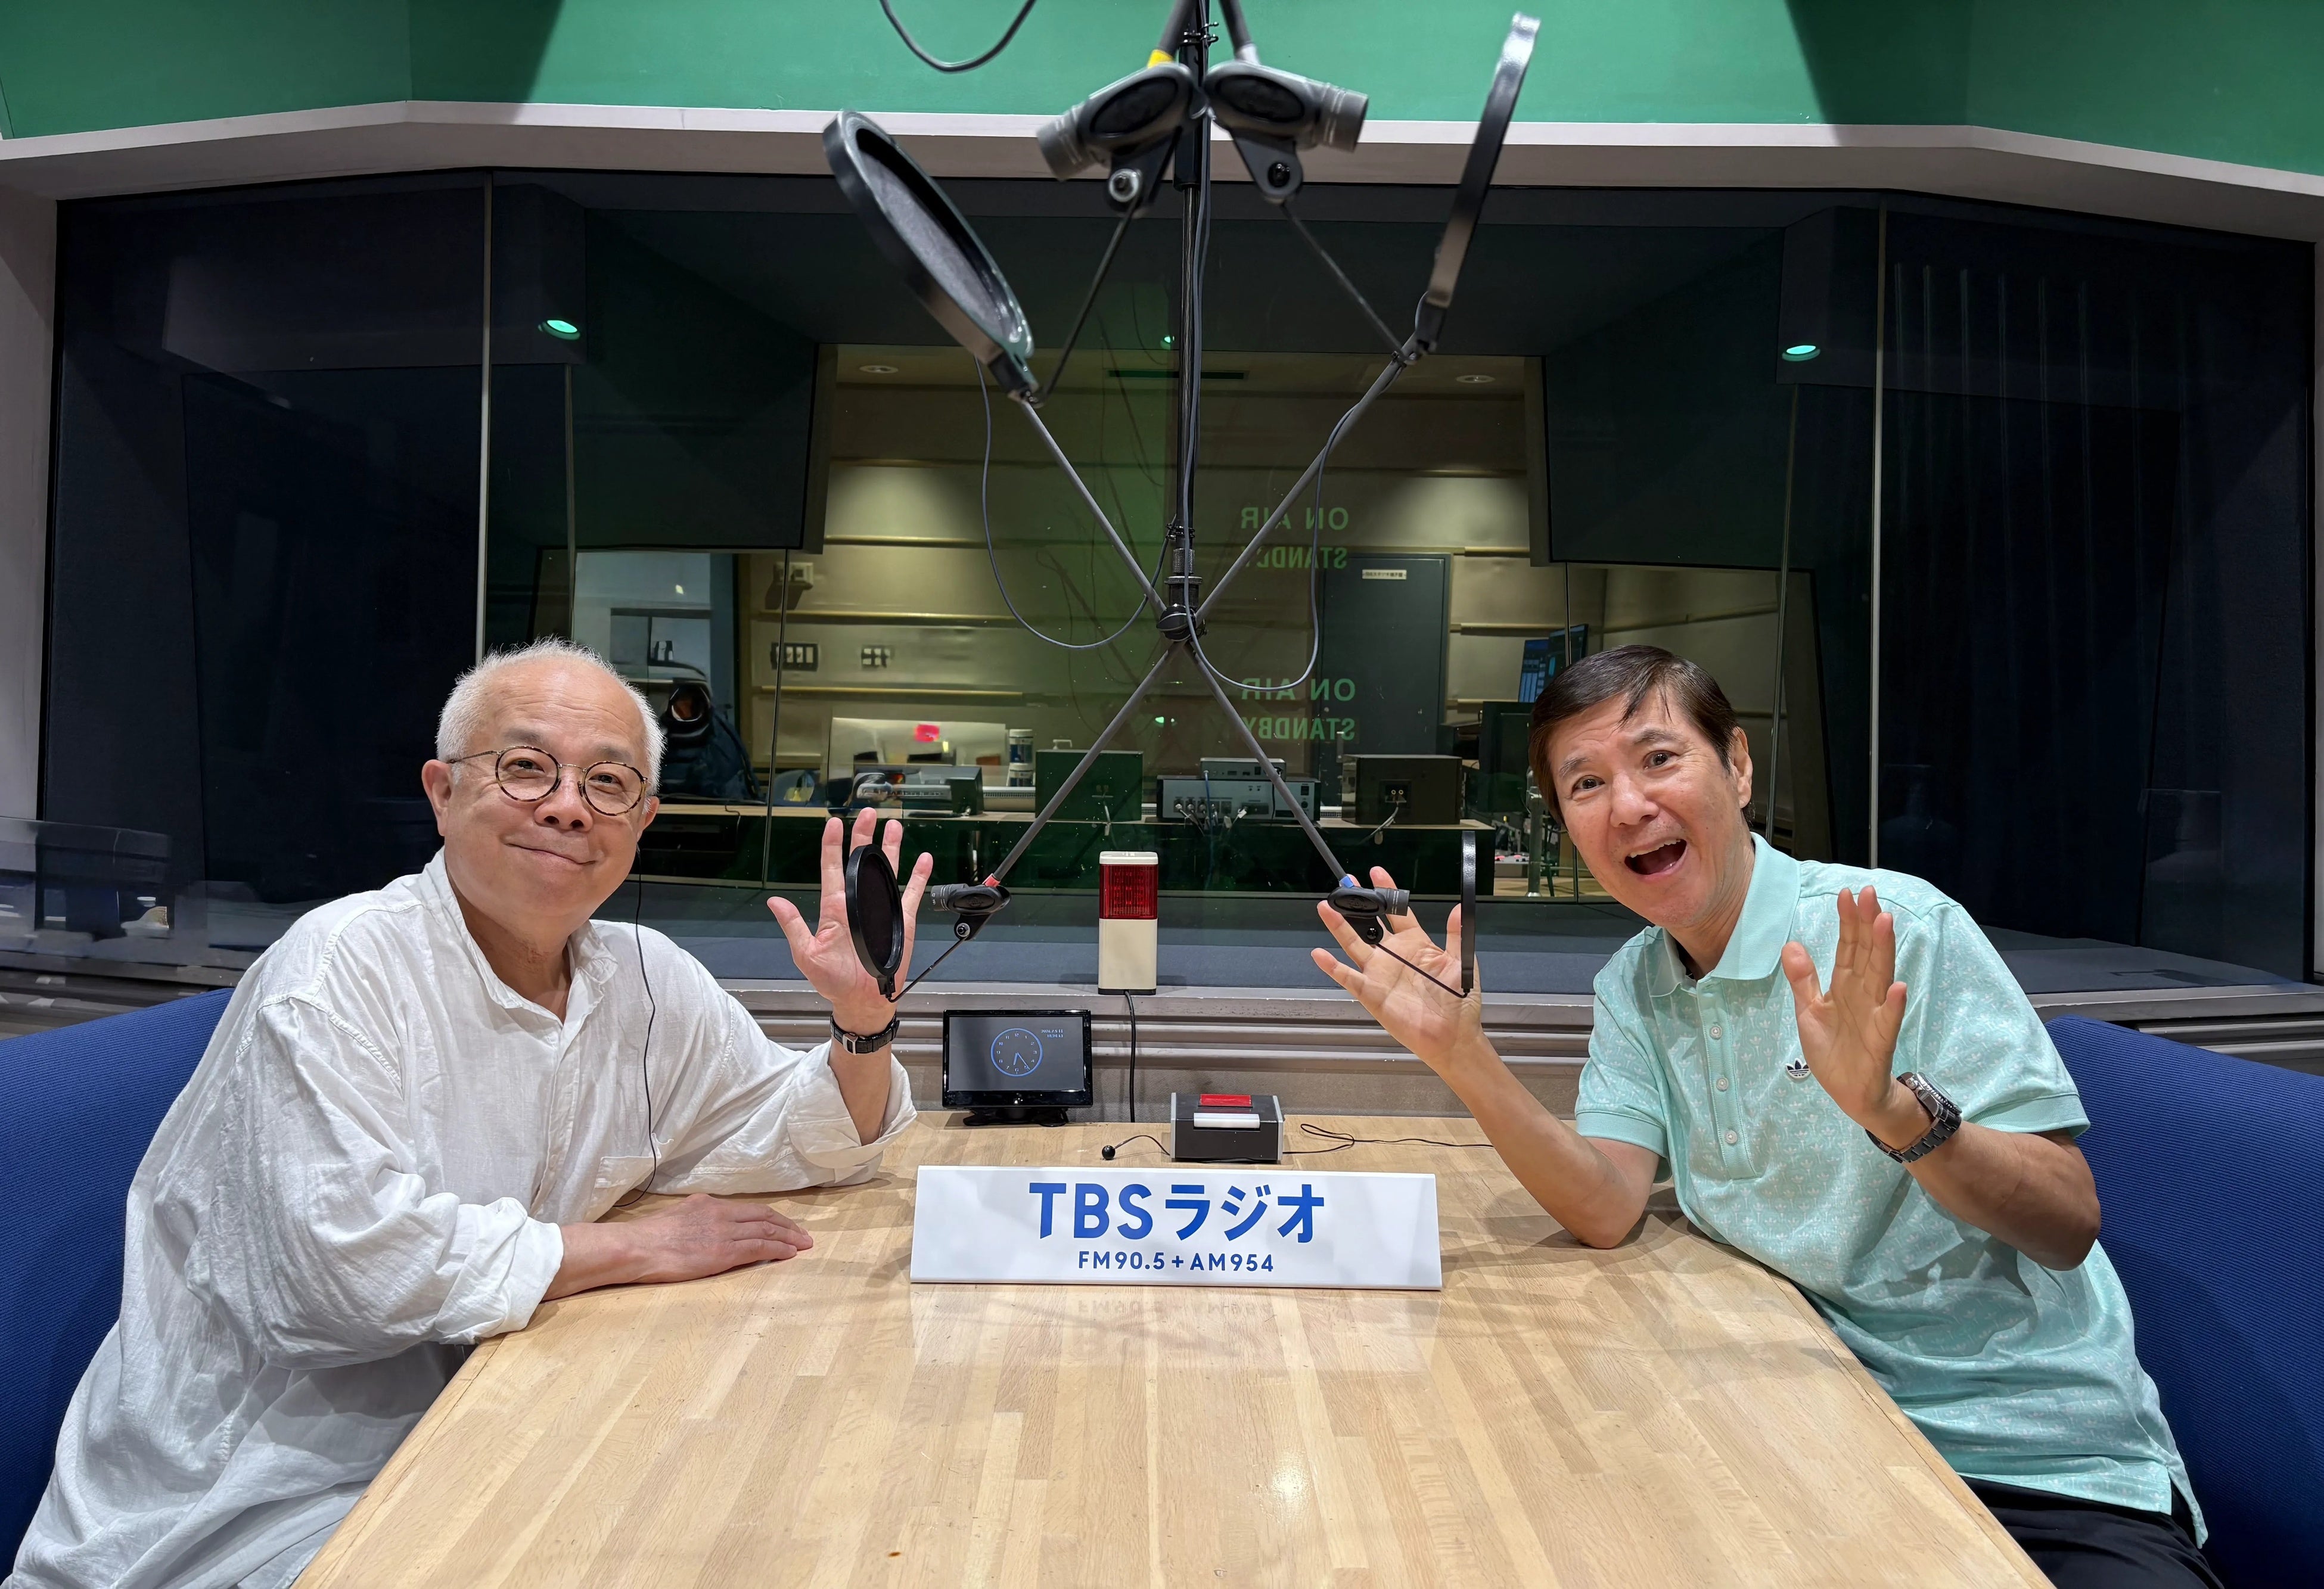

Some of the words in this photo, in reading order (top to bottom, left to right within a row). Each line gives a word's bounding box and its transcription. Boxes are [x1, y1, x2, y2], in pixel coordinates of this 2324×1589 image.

[1029, 1183, 1324, 1243] TBSラジオ
[1079, 1251, 1273, 1272] FM90.5+AM954
